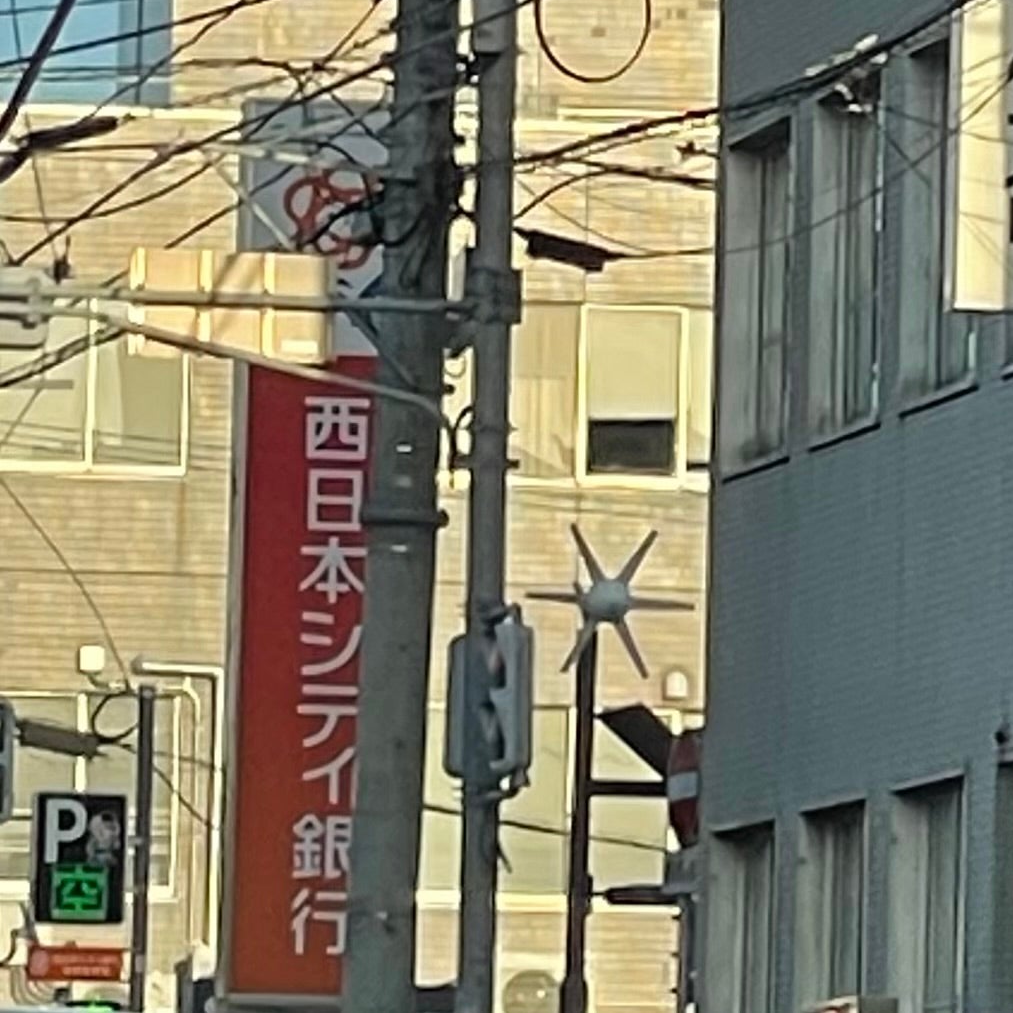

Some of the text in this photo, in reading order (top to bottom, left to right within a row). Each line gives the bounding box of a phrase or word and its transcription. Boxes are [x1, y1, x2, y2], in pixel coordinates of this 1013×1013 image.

[290, 396, 371, 955] 西日本シティ銀行
[45, 798, 88, 863] P
[51, 864, 109, 919] 空
